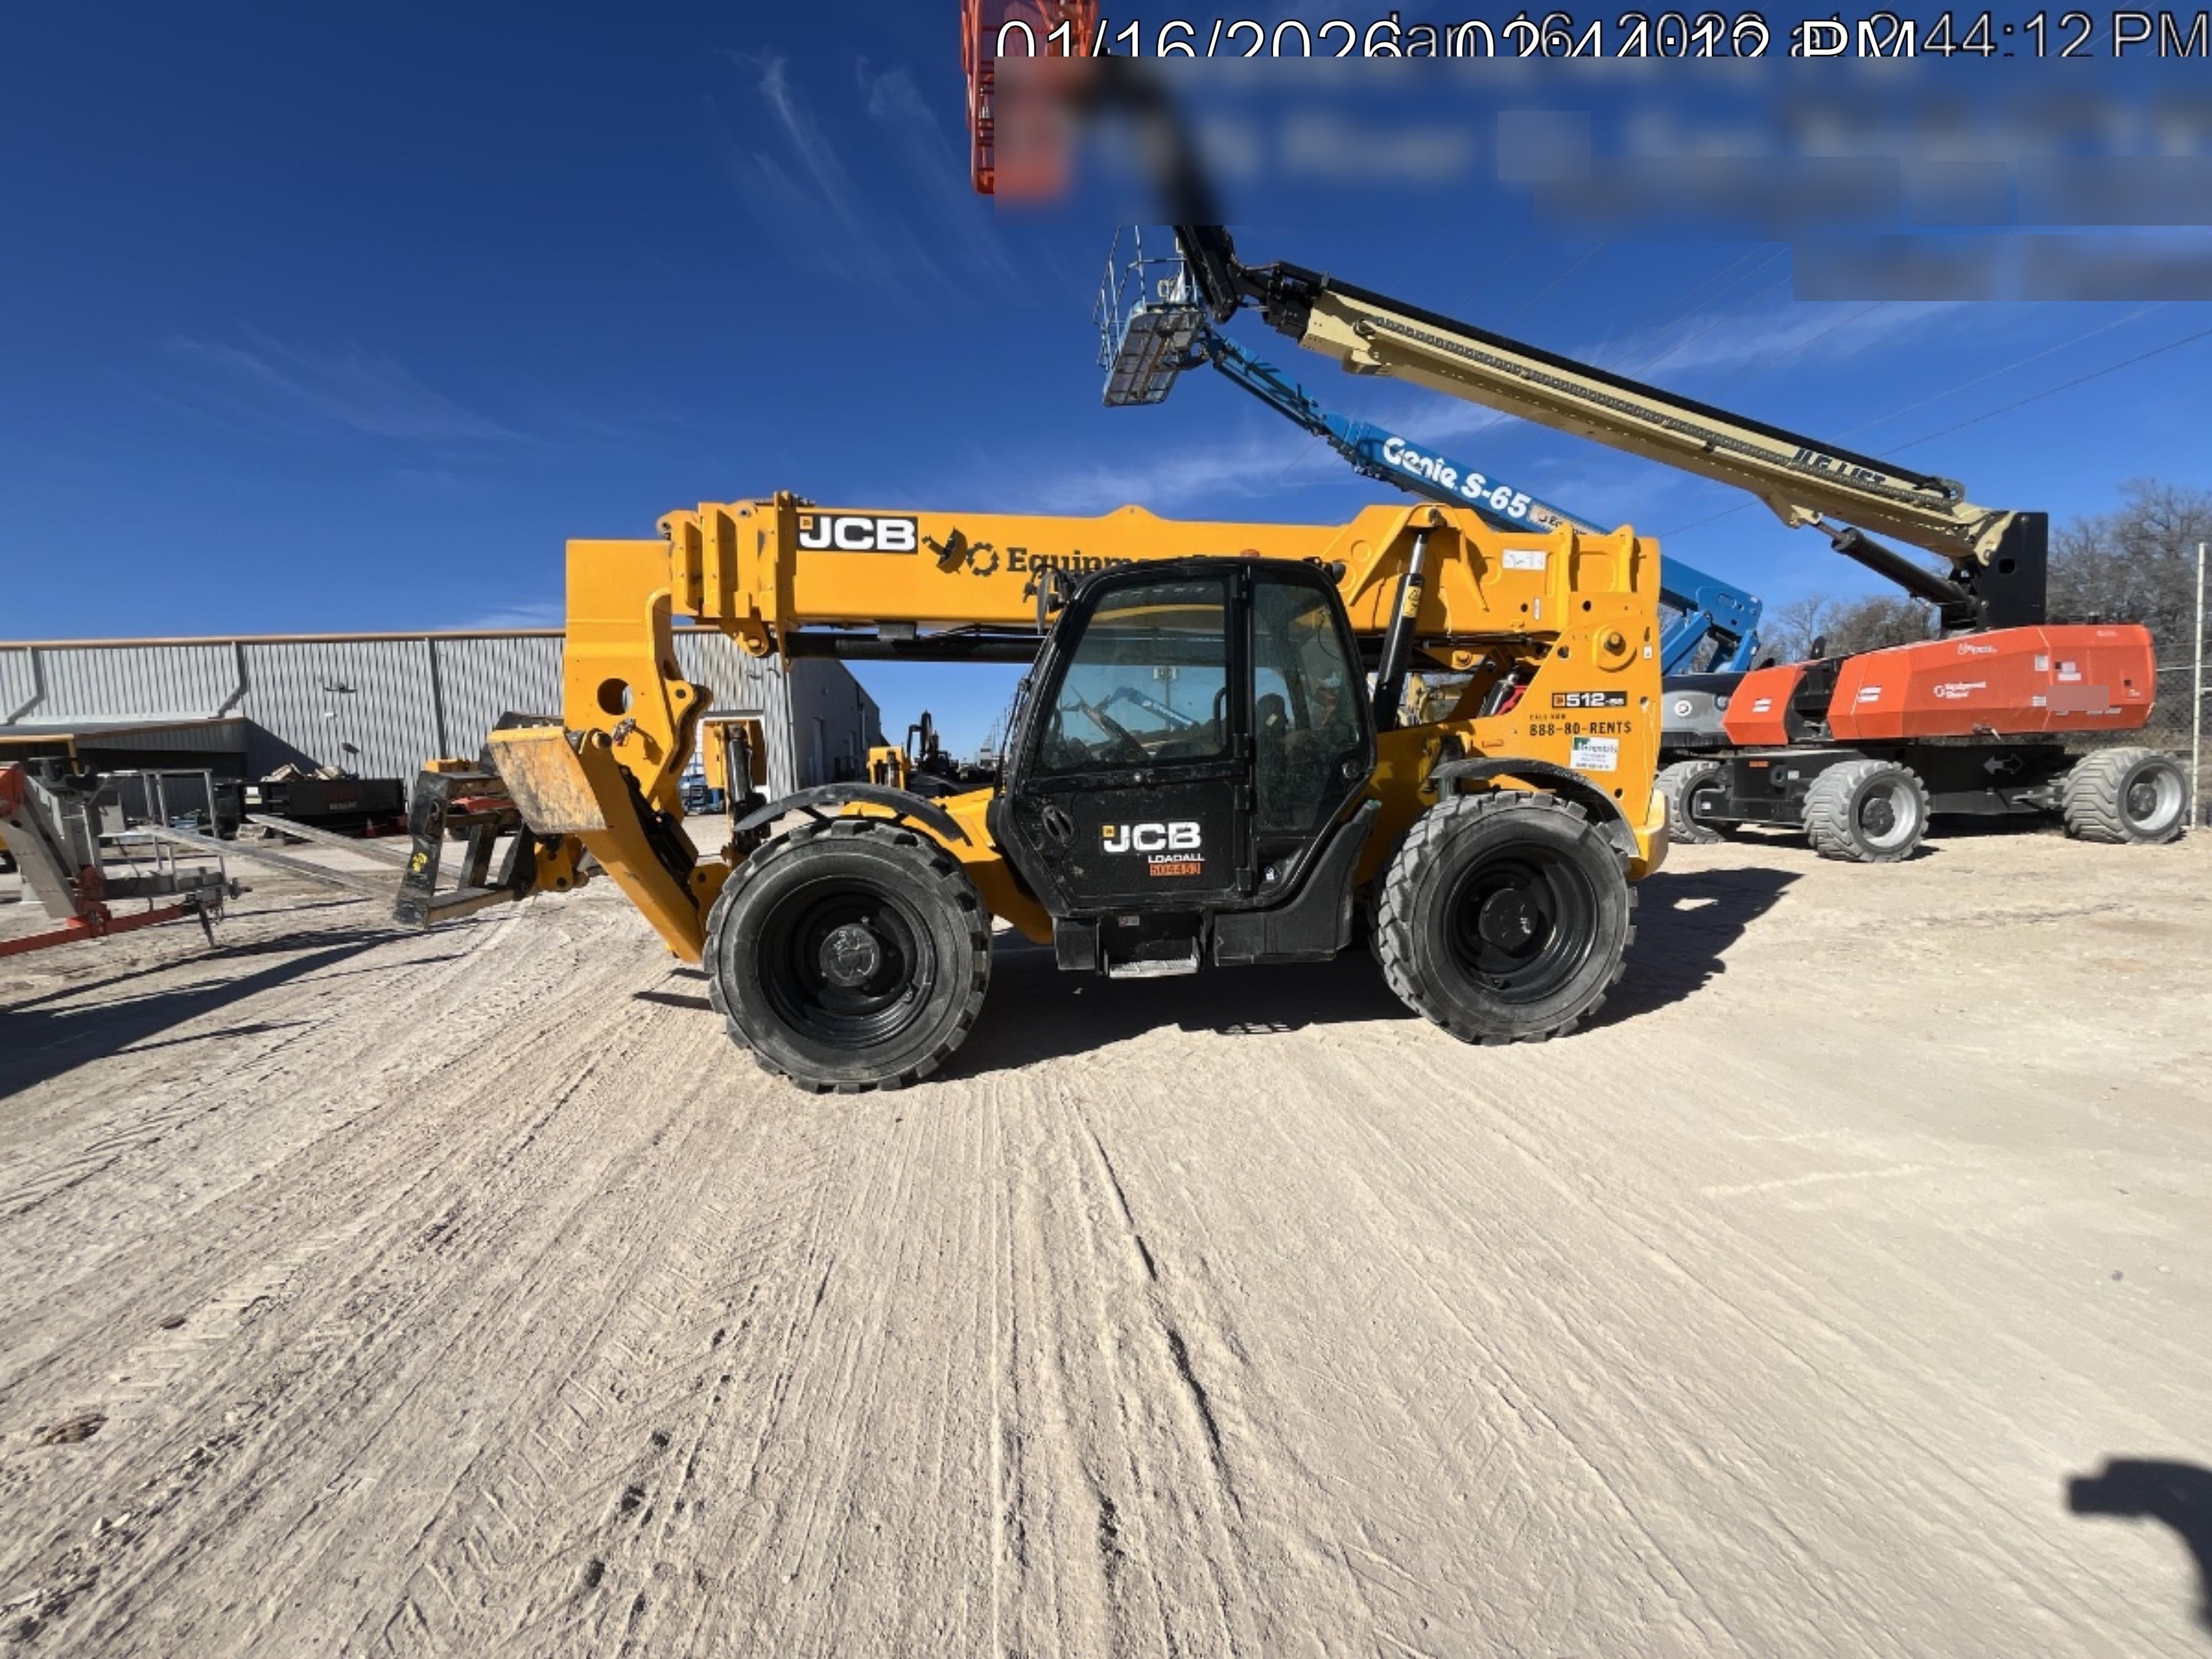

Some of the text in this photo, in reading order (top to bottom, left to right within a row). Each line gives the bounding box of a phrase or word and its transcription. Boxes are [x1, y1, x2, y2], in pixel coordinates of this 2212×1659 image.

[1382, 436, 1532, 519] Genie S-65
[799, 516, 916, 551] JCB
[1104, 822, 1201, 852] JCB
[1148, 853, 1205, 863] LOADALL
